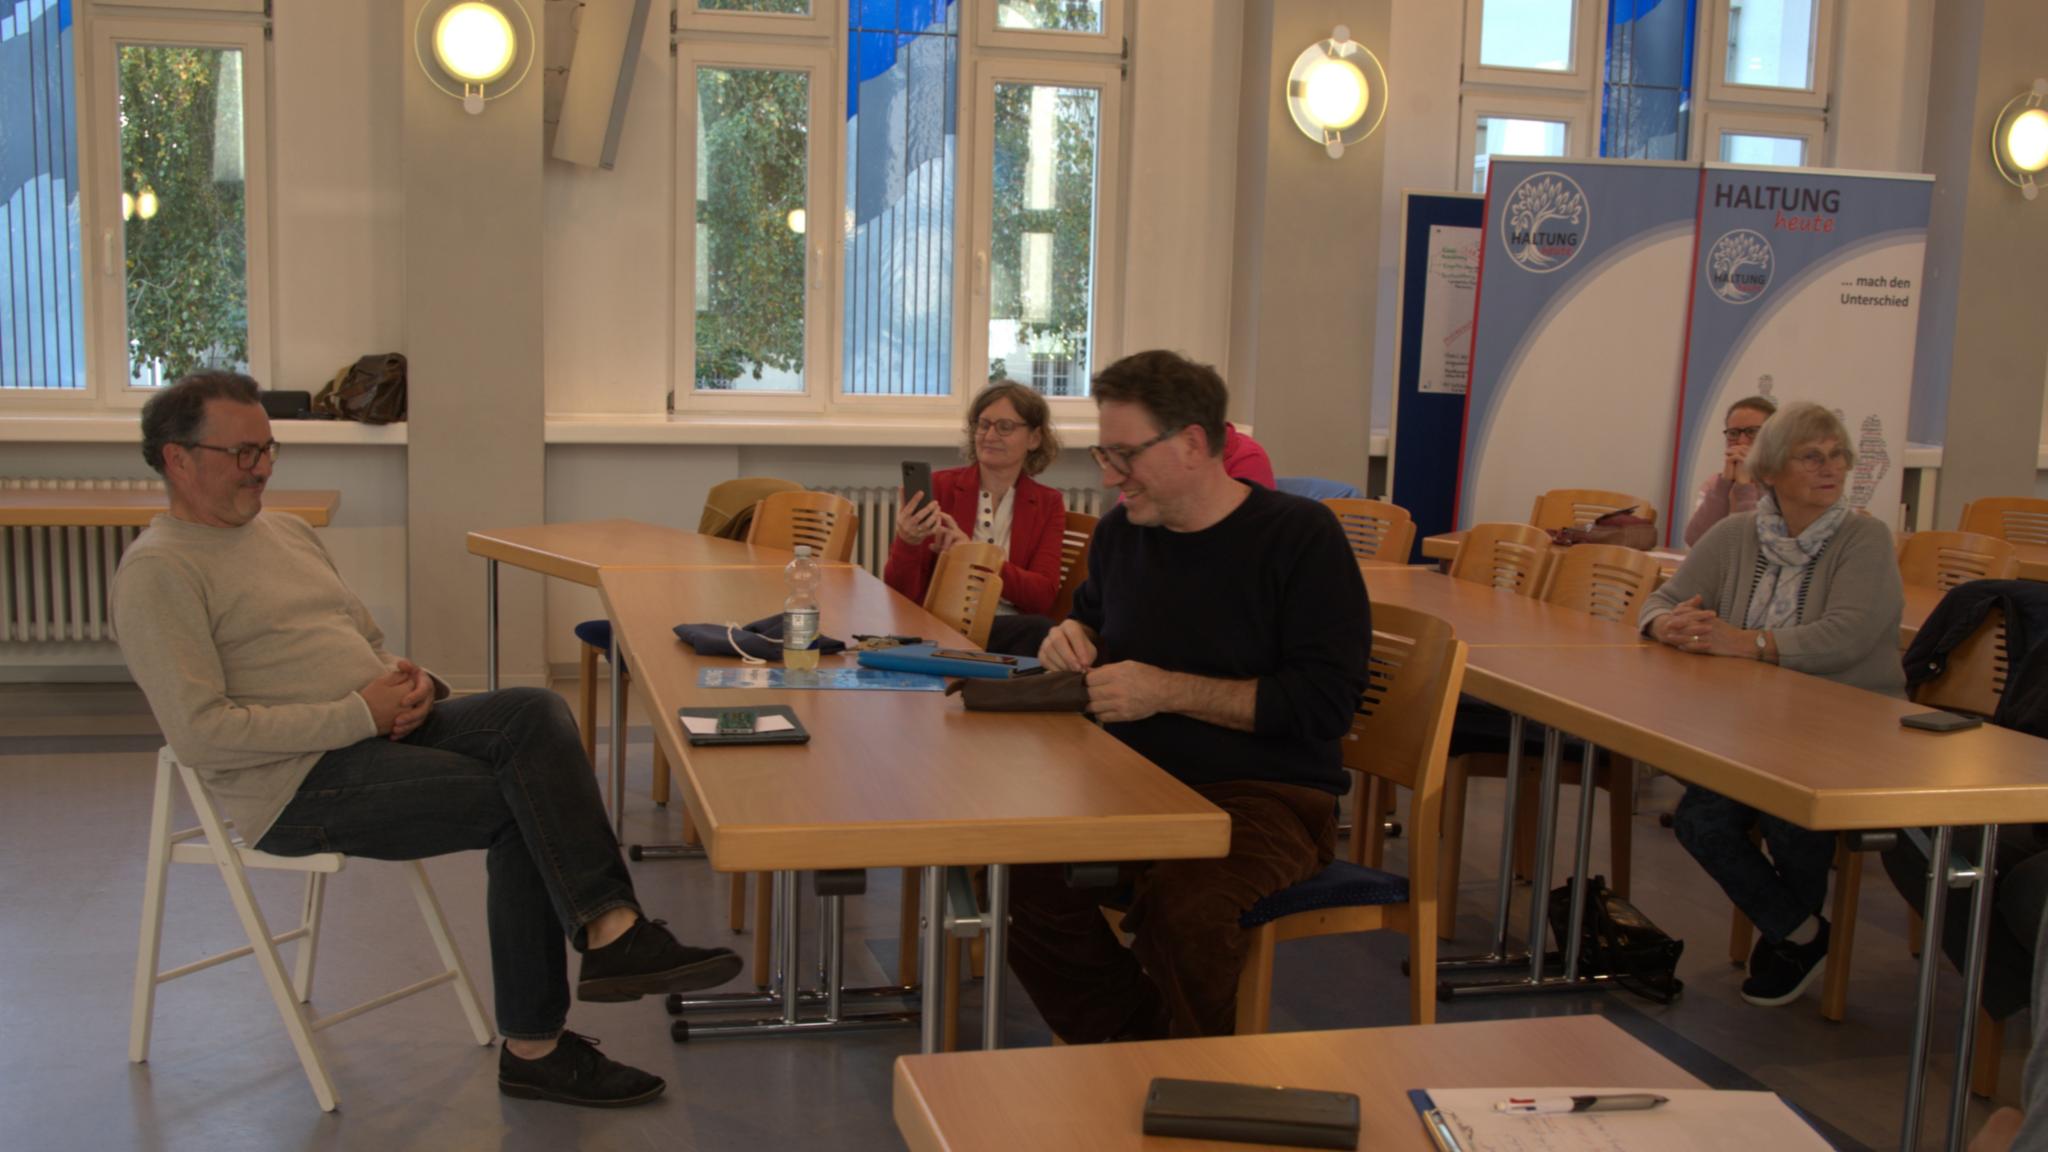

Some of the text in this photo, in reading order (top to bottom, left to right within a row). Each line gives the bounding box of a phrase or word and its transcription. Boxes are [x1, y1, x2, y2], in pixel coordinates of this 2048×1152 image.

[1715, 183, 1841, 213] HALTUNG
[1773, 209, 1835, 233] heute
[1511, 231, 1577, 246] HALTUNG
[1857, 274, 1886, 287] mach
[1890, 276, 1911, 288] den
[1840, 294, 1909, 308] Unterschied
